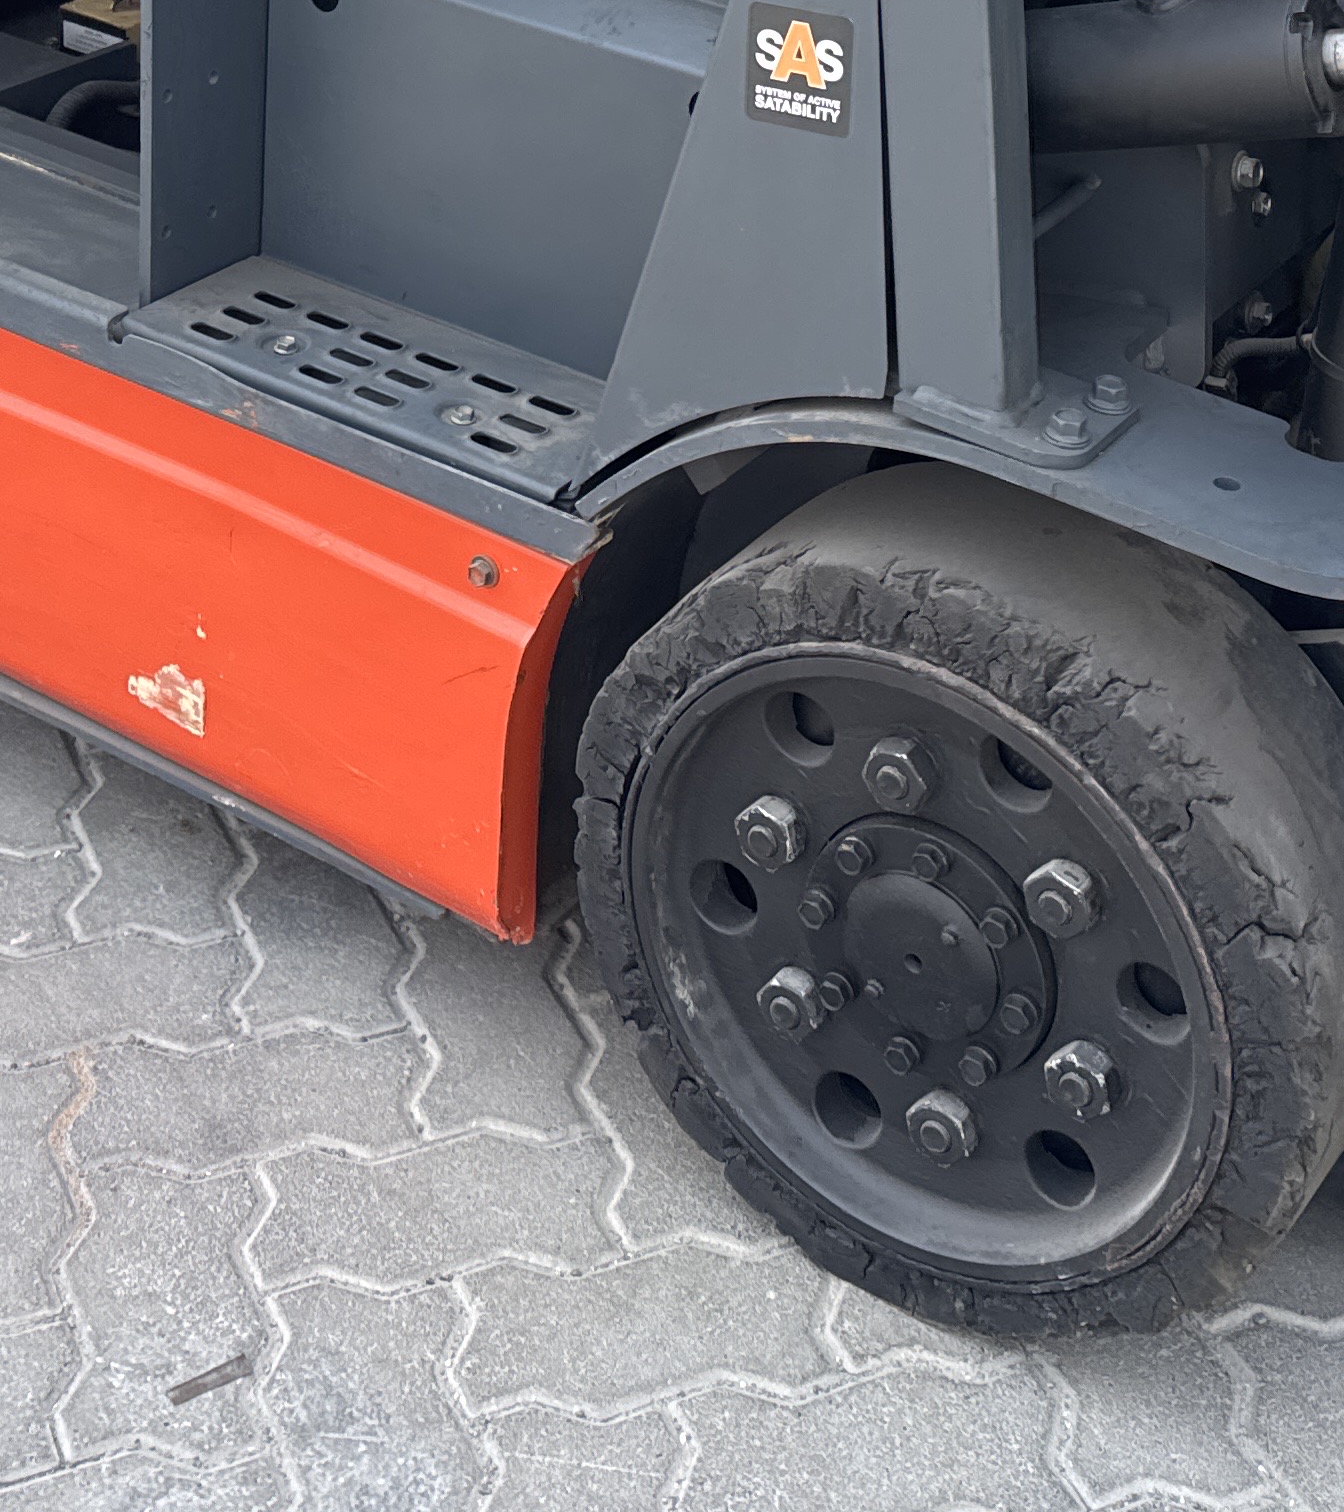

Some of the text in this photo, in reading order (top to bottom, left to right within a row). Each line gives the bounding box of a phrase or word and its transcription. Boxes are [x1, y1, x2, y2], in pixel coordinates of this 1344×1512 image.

[755, 19, 844, 90] SAS
[755, 94, 841, 124] SATABILITY
[793, 91, 807, 103] OF
[808, 95, 841, 110] ACTIVE
